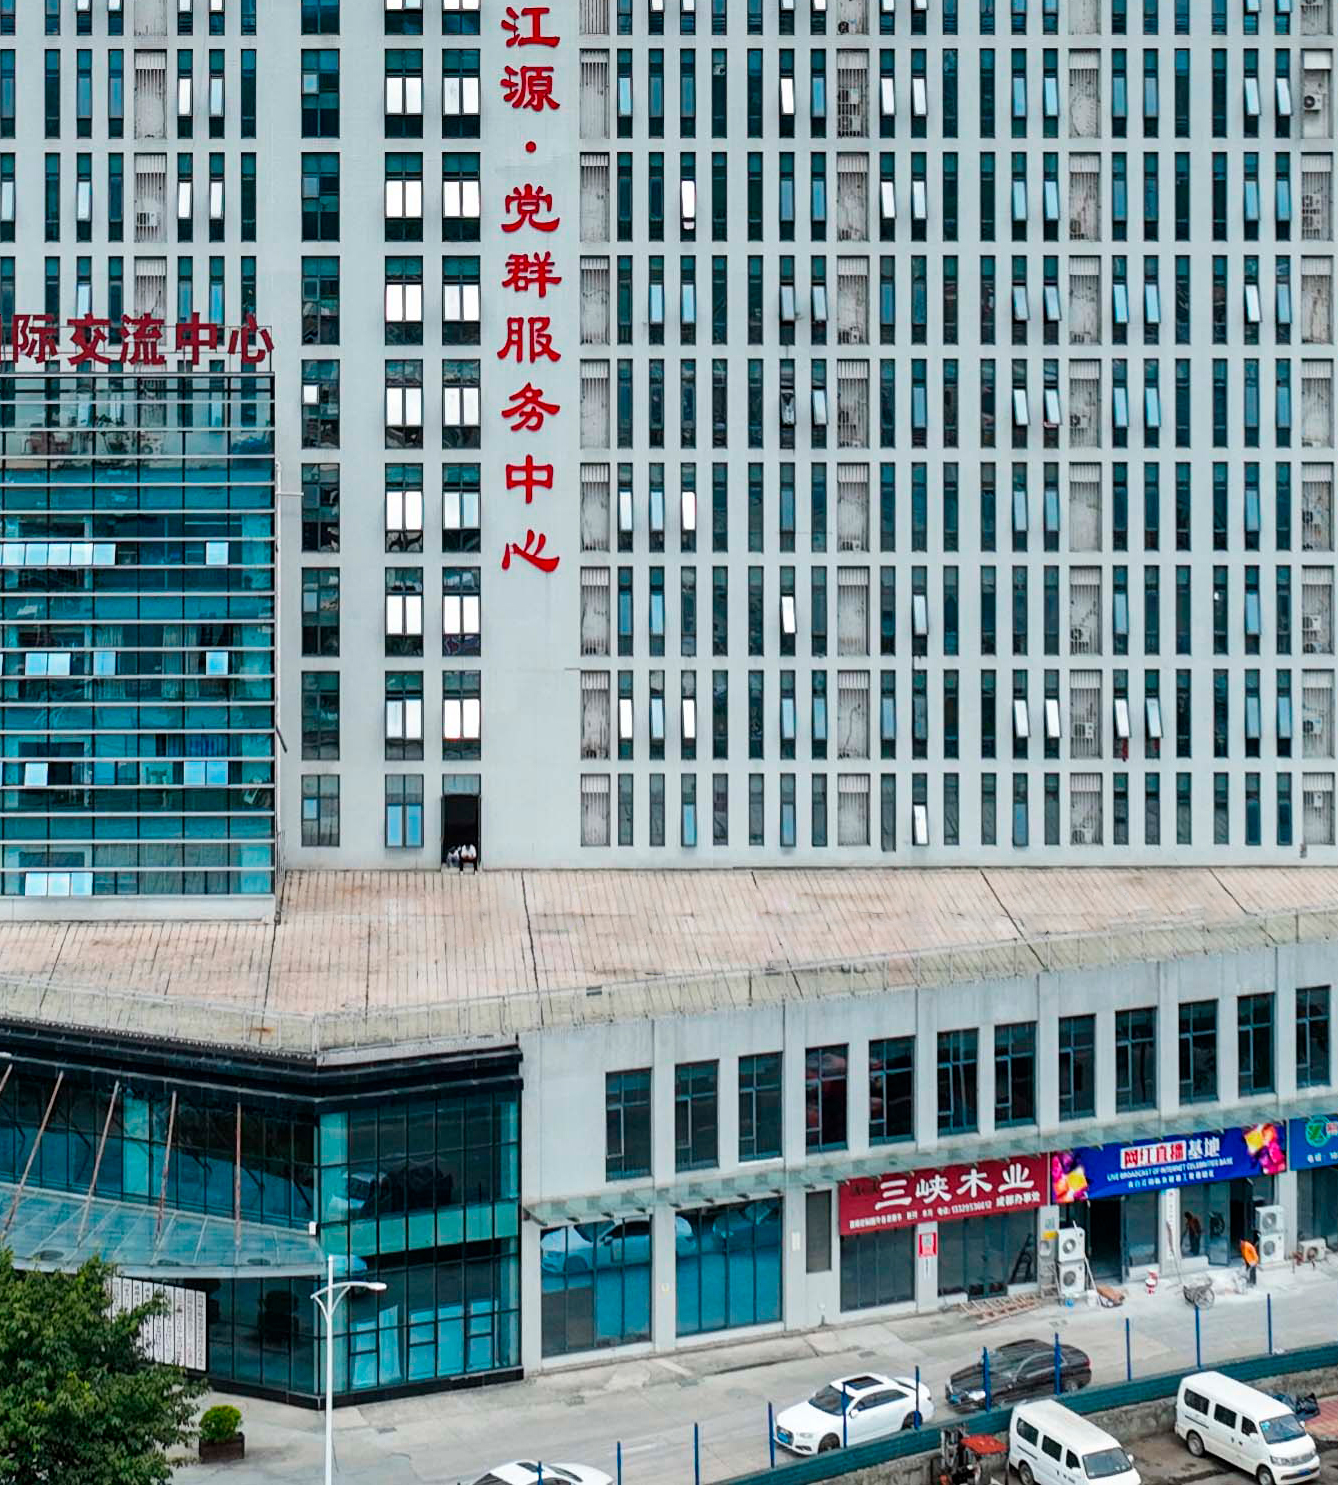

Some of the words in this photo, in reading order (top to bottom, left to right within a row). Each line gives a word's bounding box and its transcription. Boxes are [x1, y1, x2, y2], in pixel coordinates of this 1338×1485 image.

[1124, 1136, 1220, 1167] 网红直播基地
[874, 1163, 1035, 1211] 三峡木业
